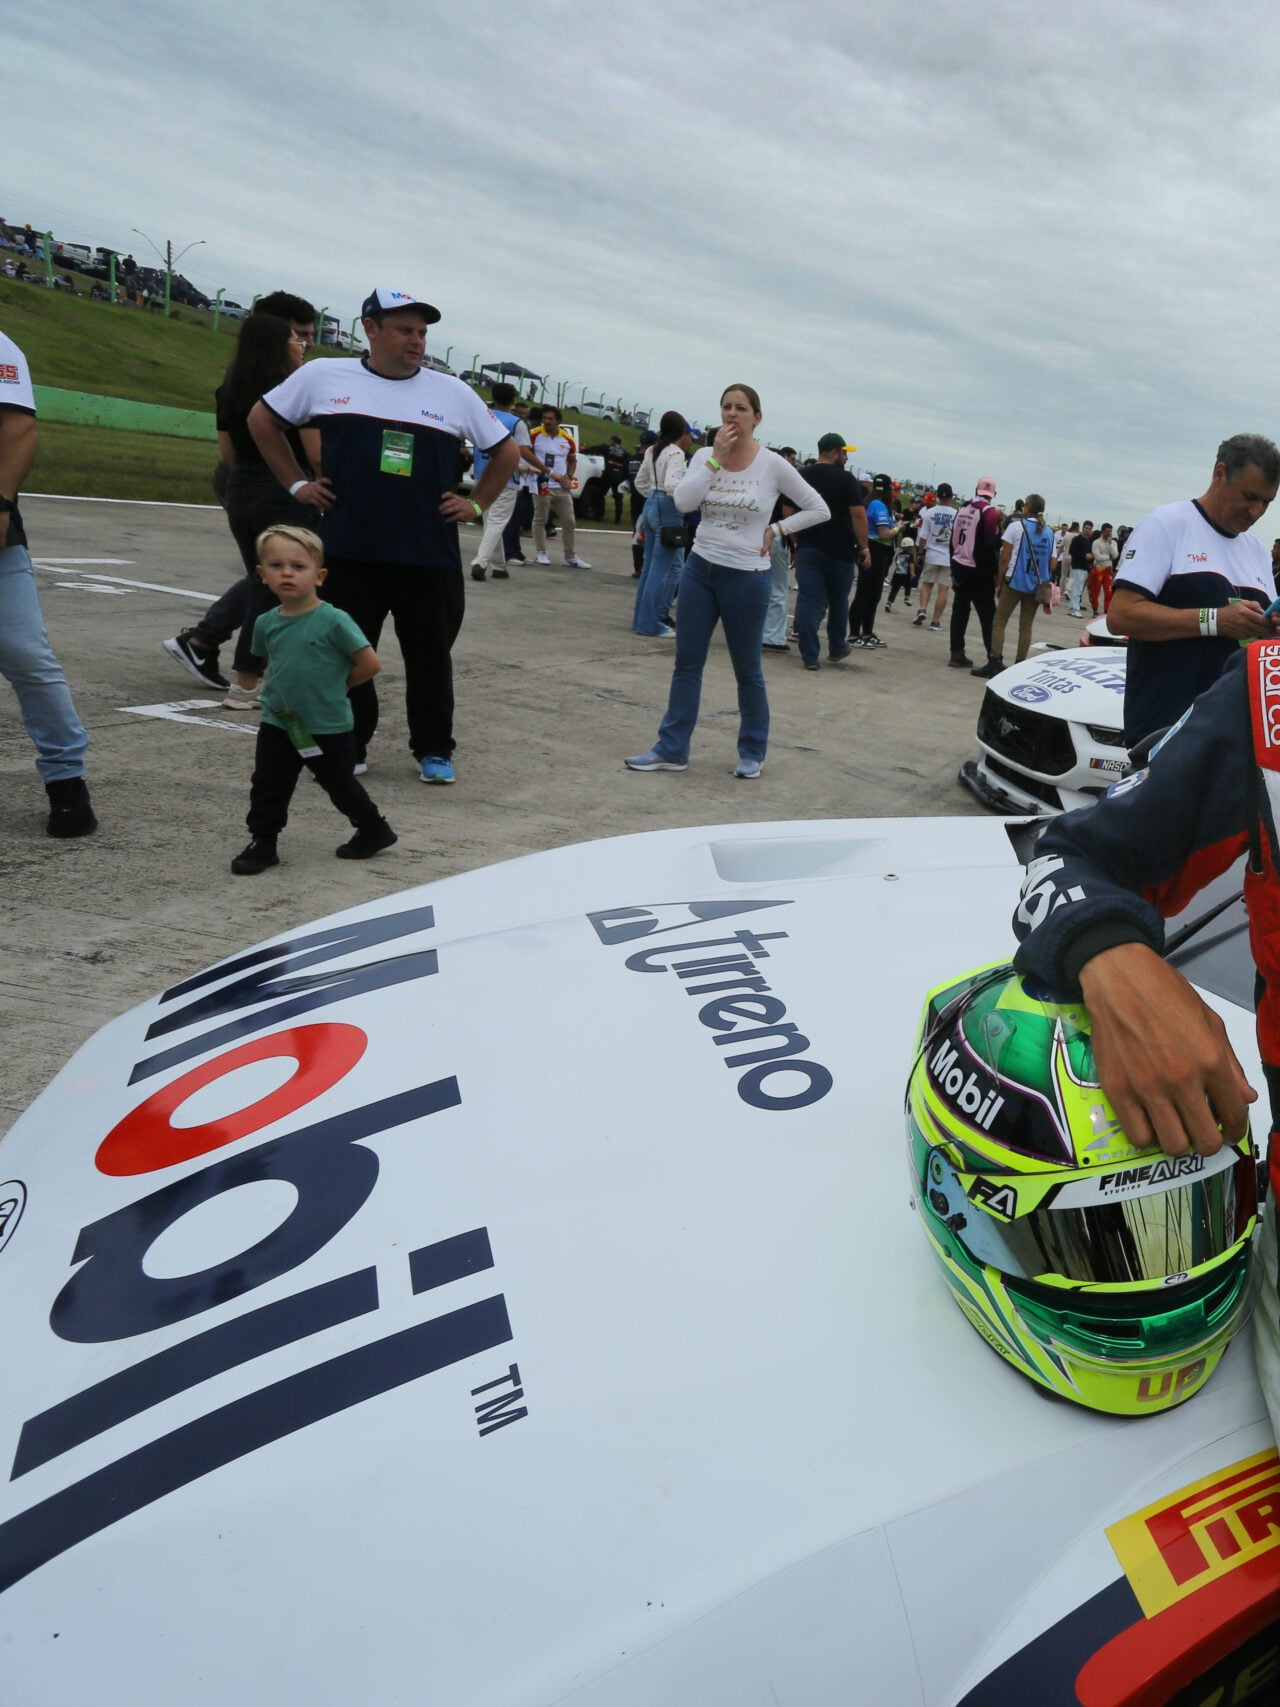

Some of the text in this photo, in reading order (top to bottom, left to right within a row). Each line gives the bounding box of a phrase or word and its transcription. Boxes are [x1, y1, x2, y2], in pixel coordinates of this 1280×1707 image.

[421, 409, 444, 422] Mobil
[1026, 669, 1083, 694] Tintas
[1101, 759, 1130, 772] NASC
[930, 1038, 1005, 1131] Mobil
[0, 905, 513, 1594] Mobil
